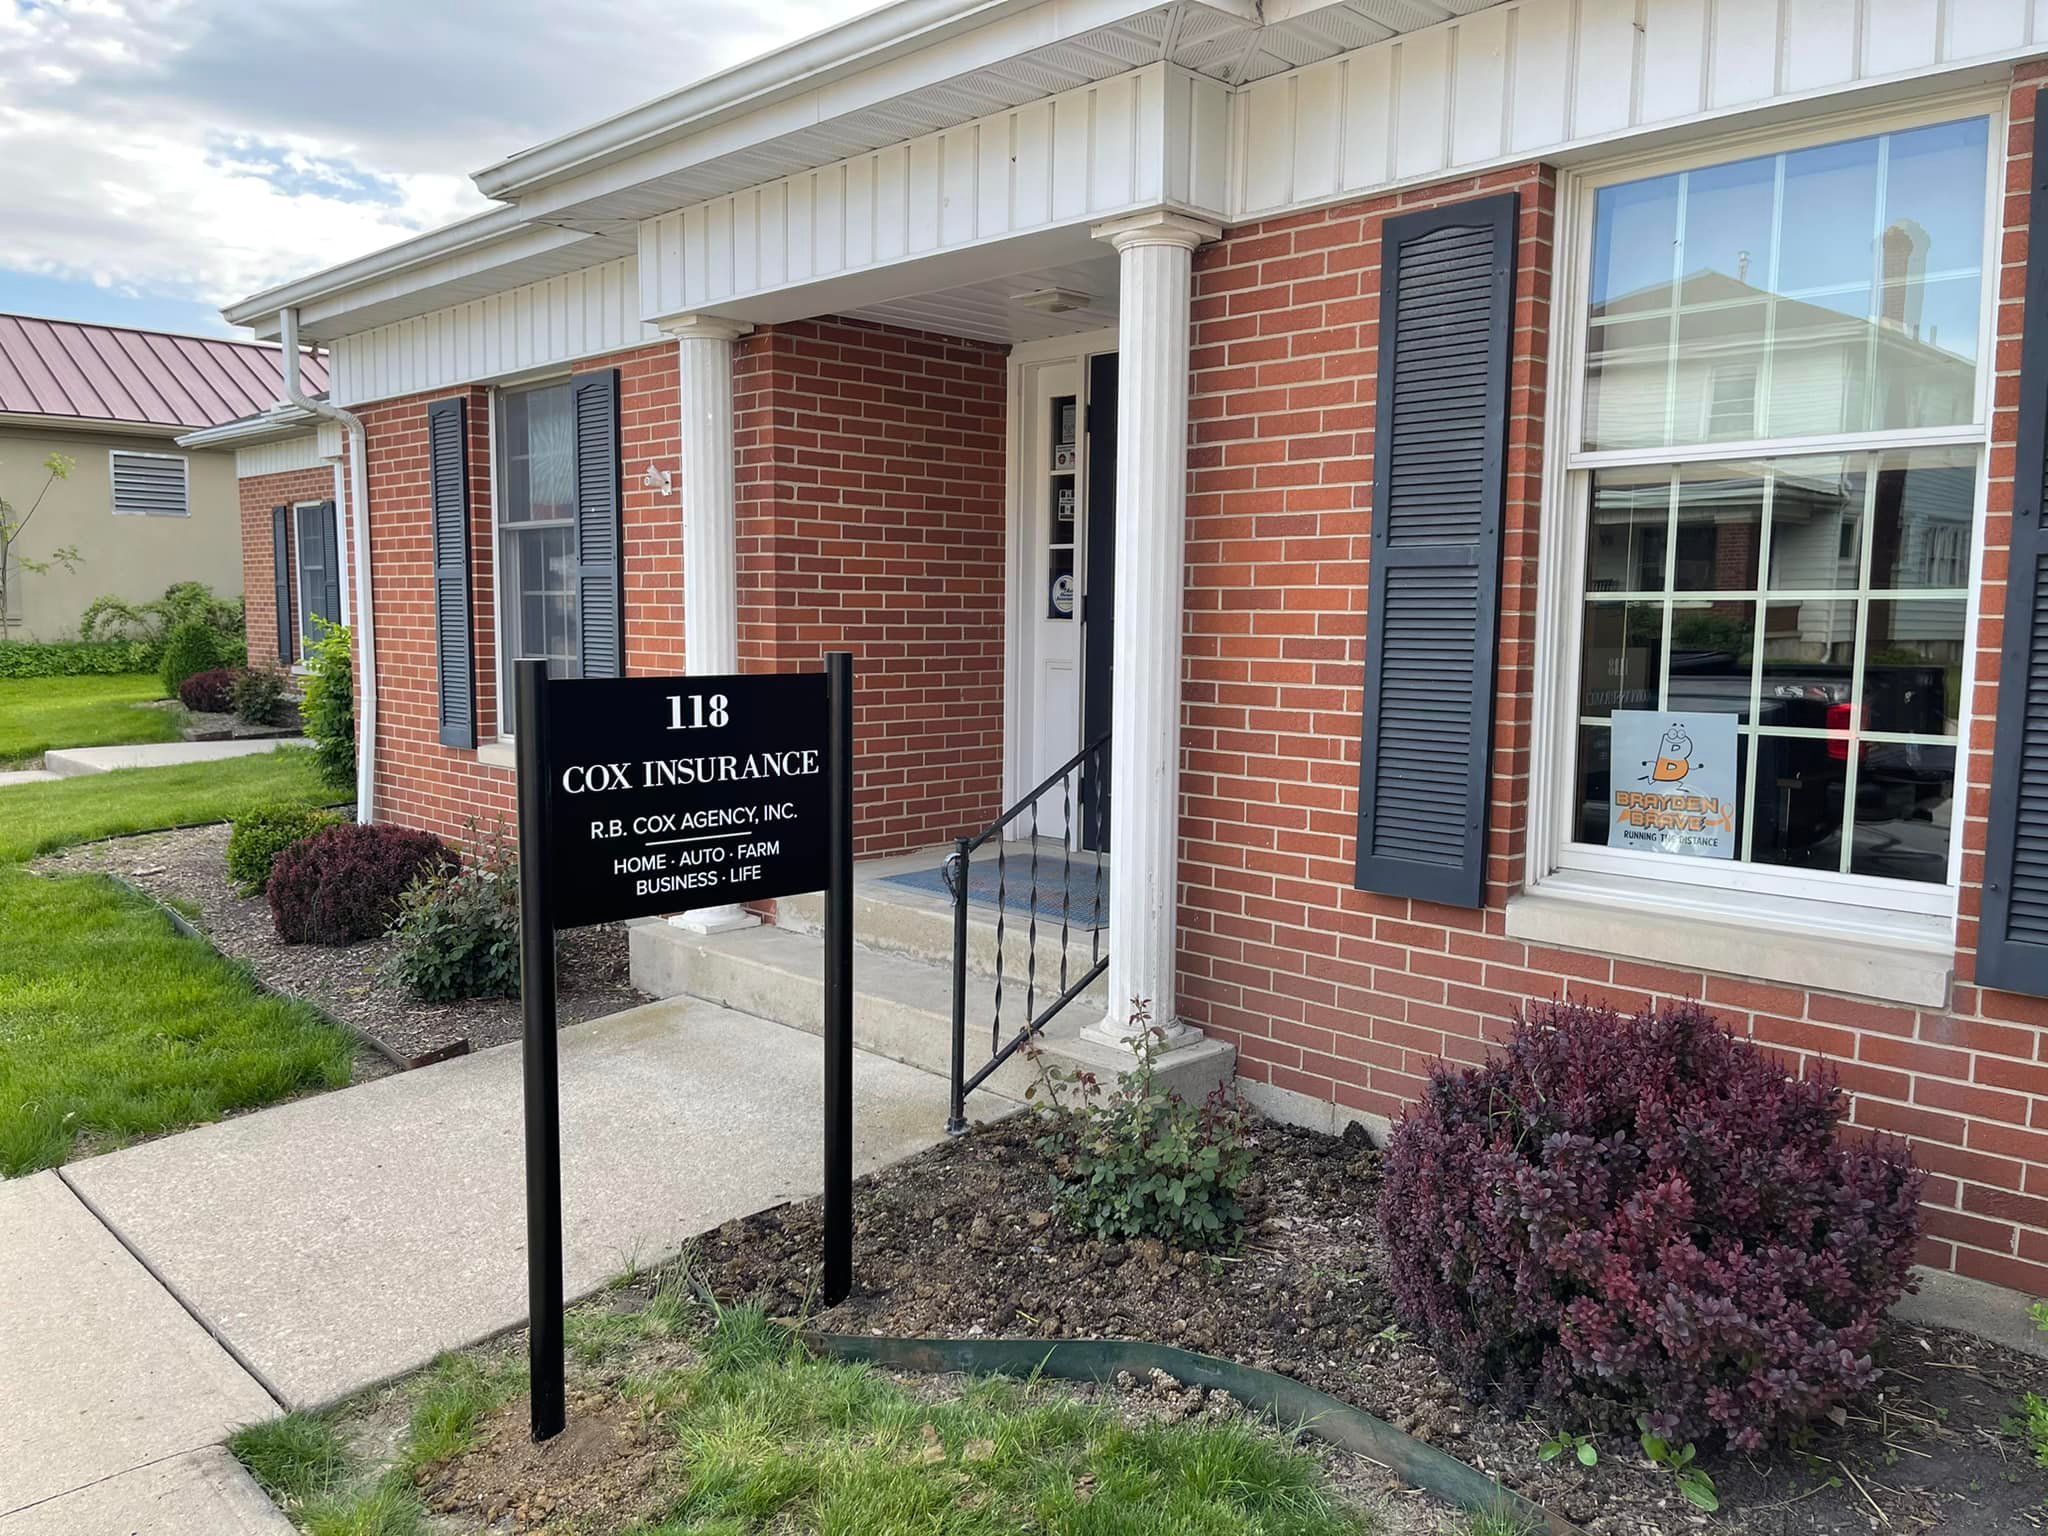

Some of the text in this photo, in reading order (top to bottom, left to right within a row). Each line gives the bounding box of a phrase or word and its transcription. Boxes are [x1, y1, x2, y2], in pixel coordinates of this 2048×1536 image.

[666, 693, 729, 730] 118
[562, 750, 820, 794] COX INSURANCE
[1615, 791, 1719, 815] BRAYDEN
[591, 802, 798, 840] R.B. COX AGENCY, INC.
[1630, 810, 1706, 832] BRAVE
[1623, 830, 1657, 842] RUNNING
[1679, 835, 1719, 847] DISTANCE
[614, 840, 780, 875] HOME AUTO FARM
[636, 864, 762, 896] BUSINESS LIFE
